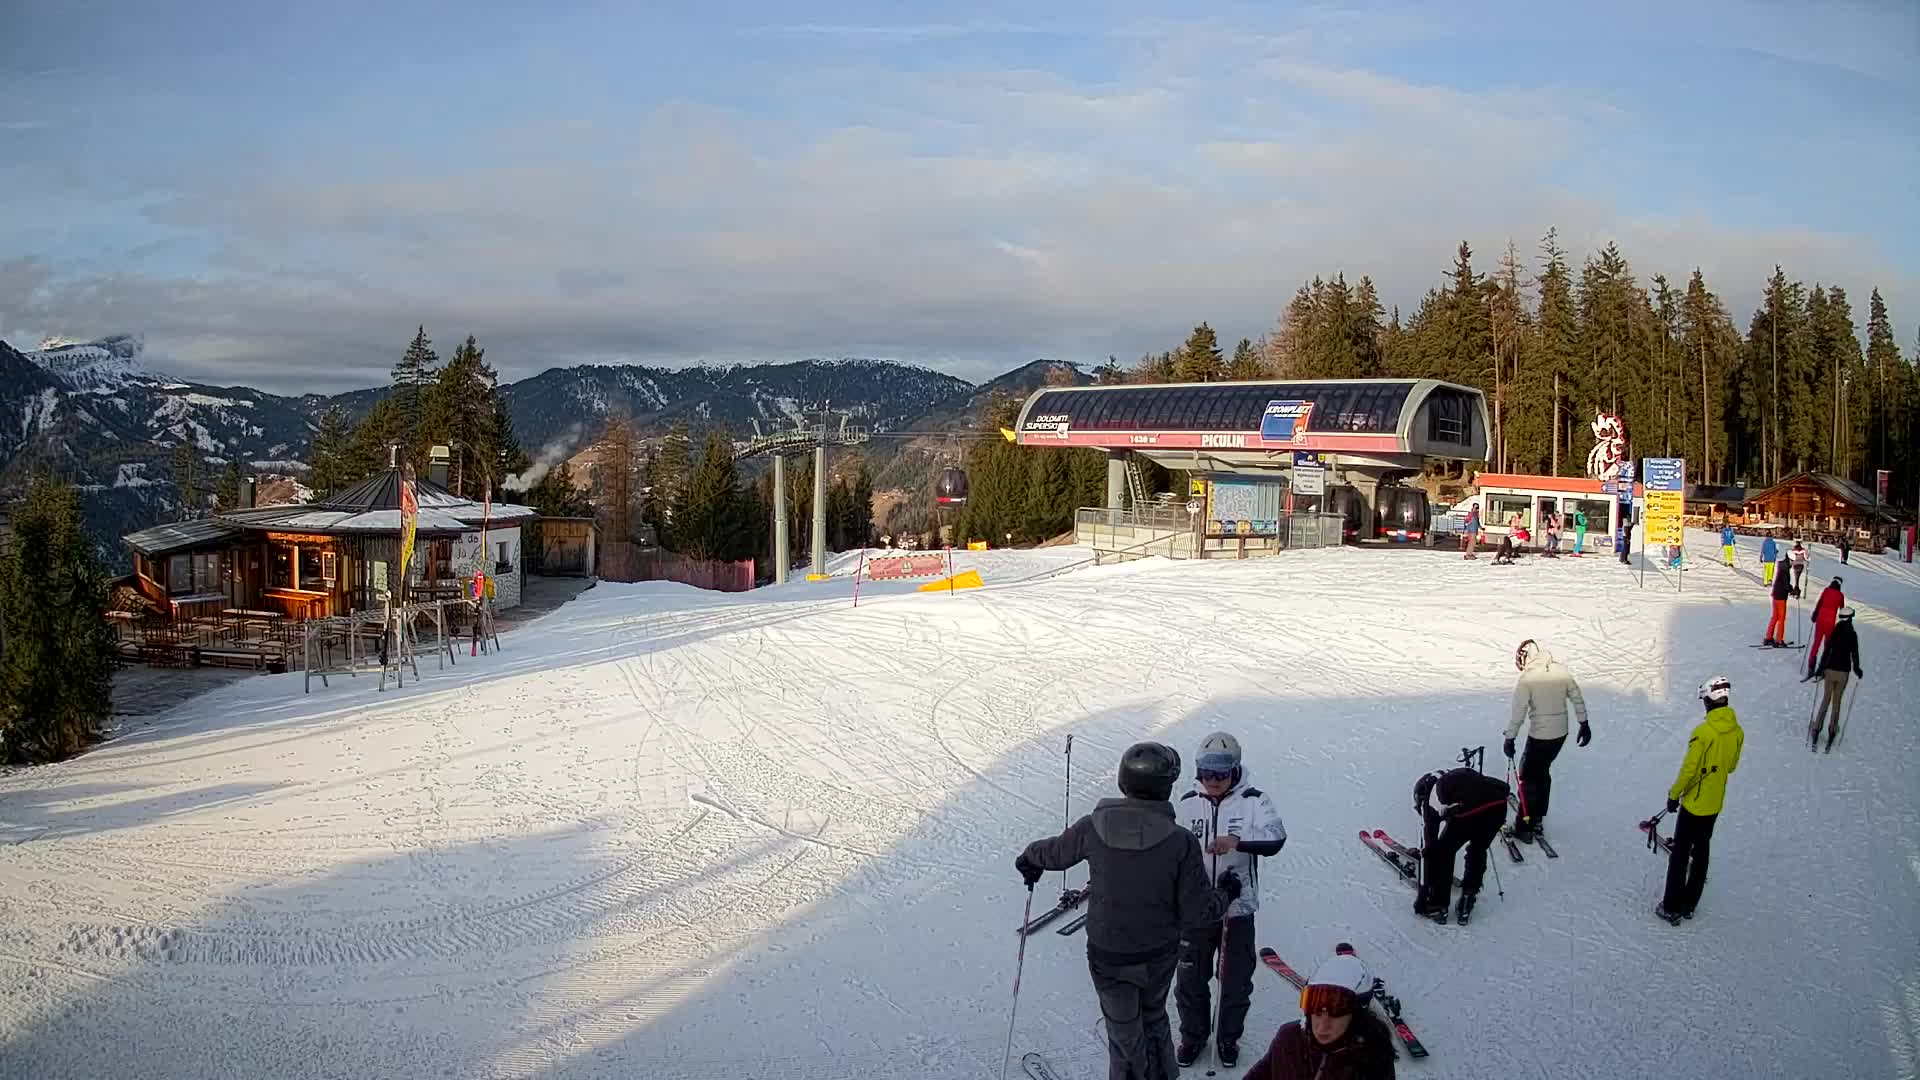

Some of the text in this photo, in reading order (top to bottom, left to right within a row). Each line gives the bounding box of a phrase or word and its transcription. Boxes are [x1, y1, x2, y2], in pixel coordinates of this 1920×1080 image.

[1266, 405, 1310, 414] KRONPLATZ
[1025, 422, 1059, 430] SUPERSKI
[1201, 434, 1245, 448] PICULIN
